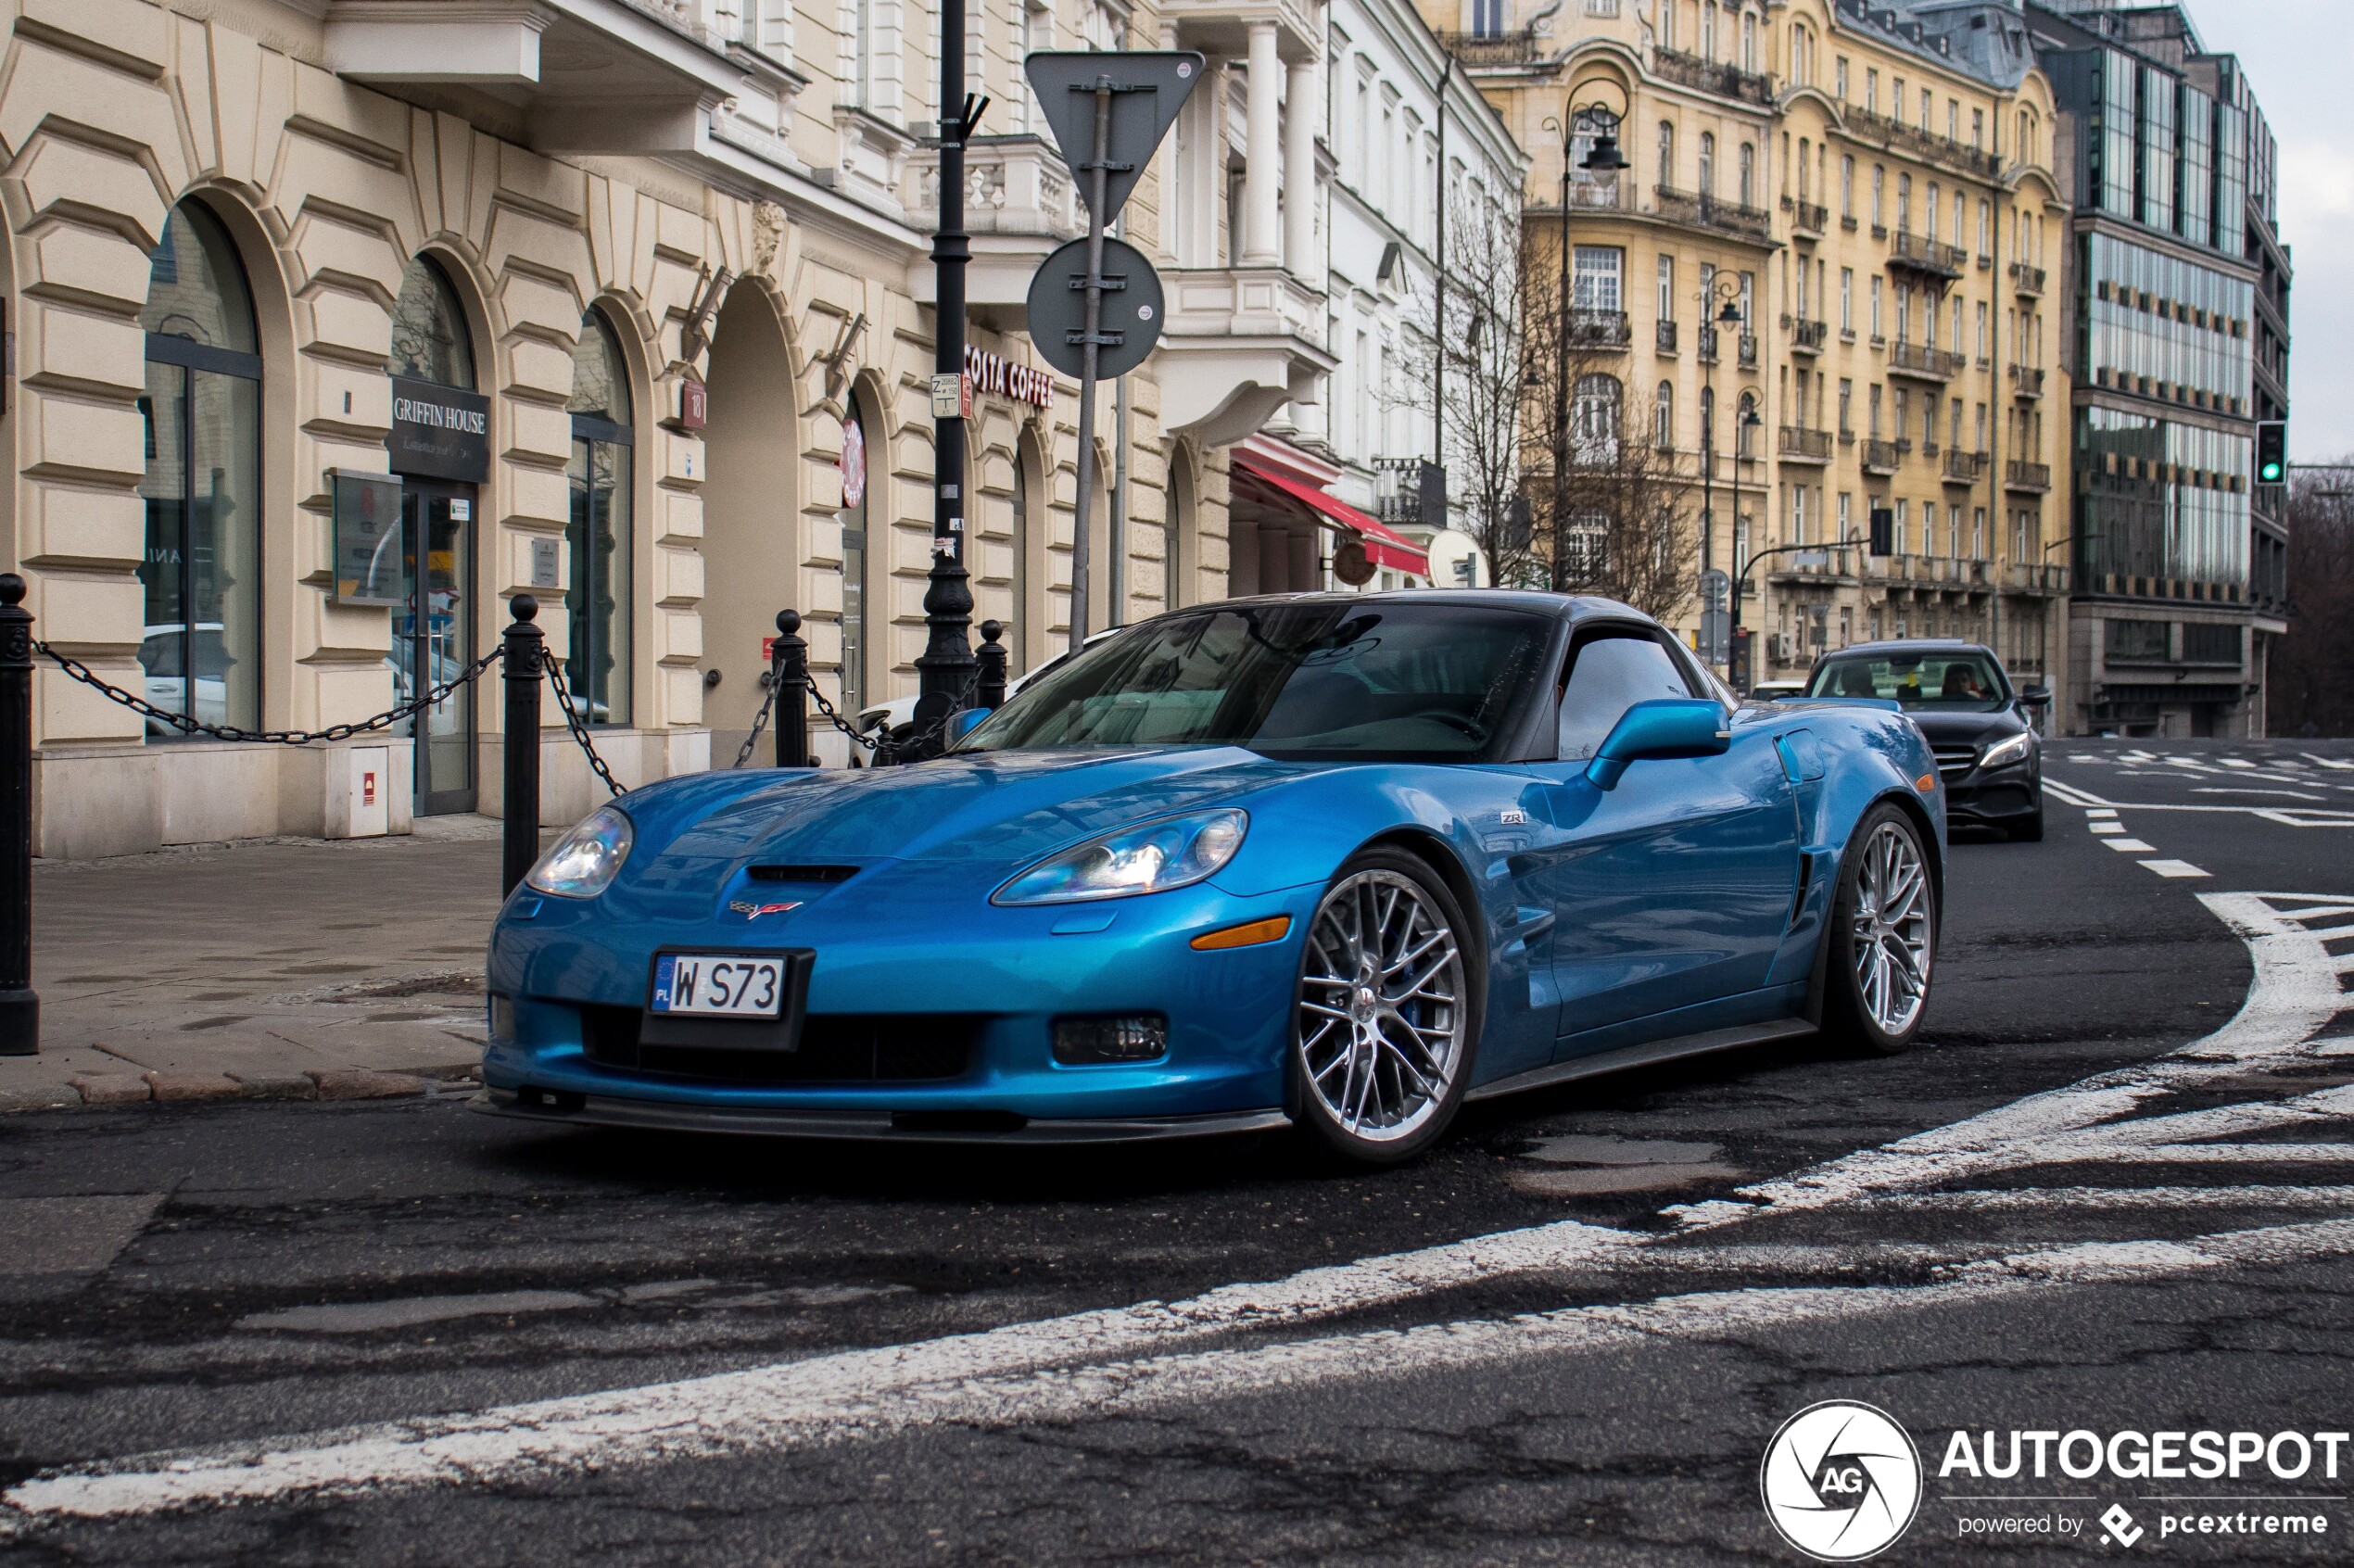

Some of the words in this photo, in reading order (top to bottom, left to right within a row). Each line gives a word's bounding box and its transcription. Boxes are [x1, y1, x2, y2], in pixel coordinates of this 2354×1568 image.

[932, 381, 941, 393] Z
[1010, 362, 1054, 409] COFFEE
[394, 398, 443, 426] GRIFFIN
[446, 407, 486, 434] HOUSE
[692, 394, 701, 418] 18
[655, 989, 669, 1001] PL
[675, 961, 699, 1006] W
[708, 962, 777, 1009] S73
